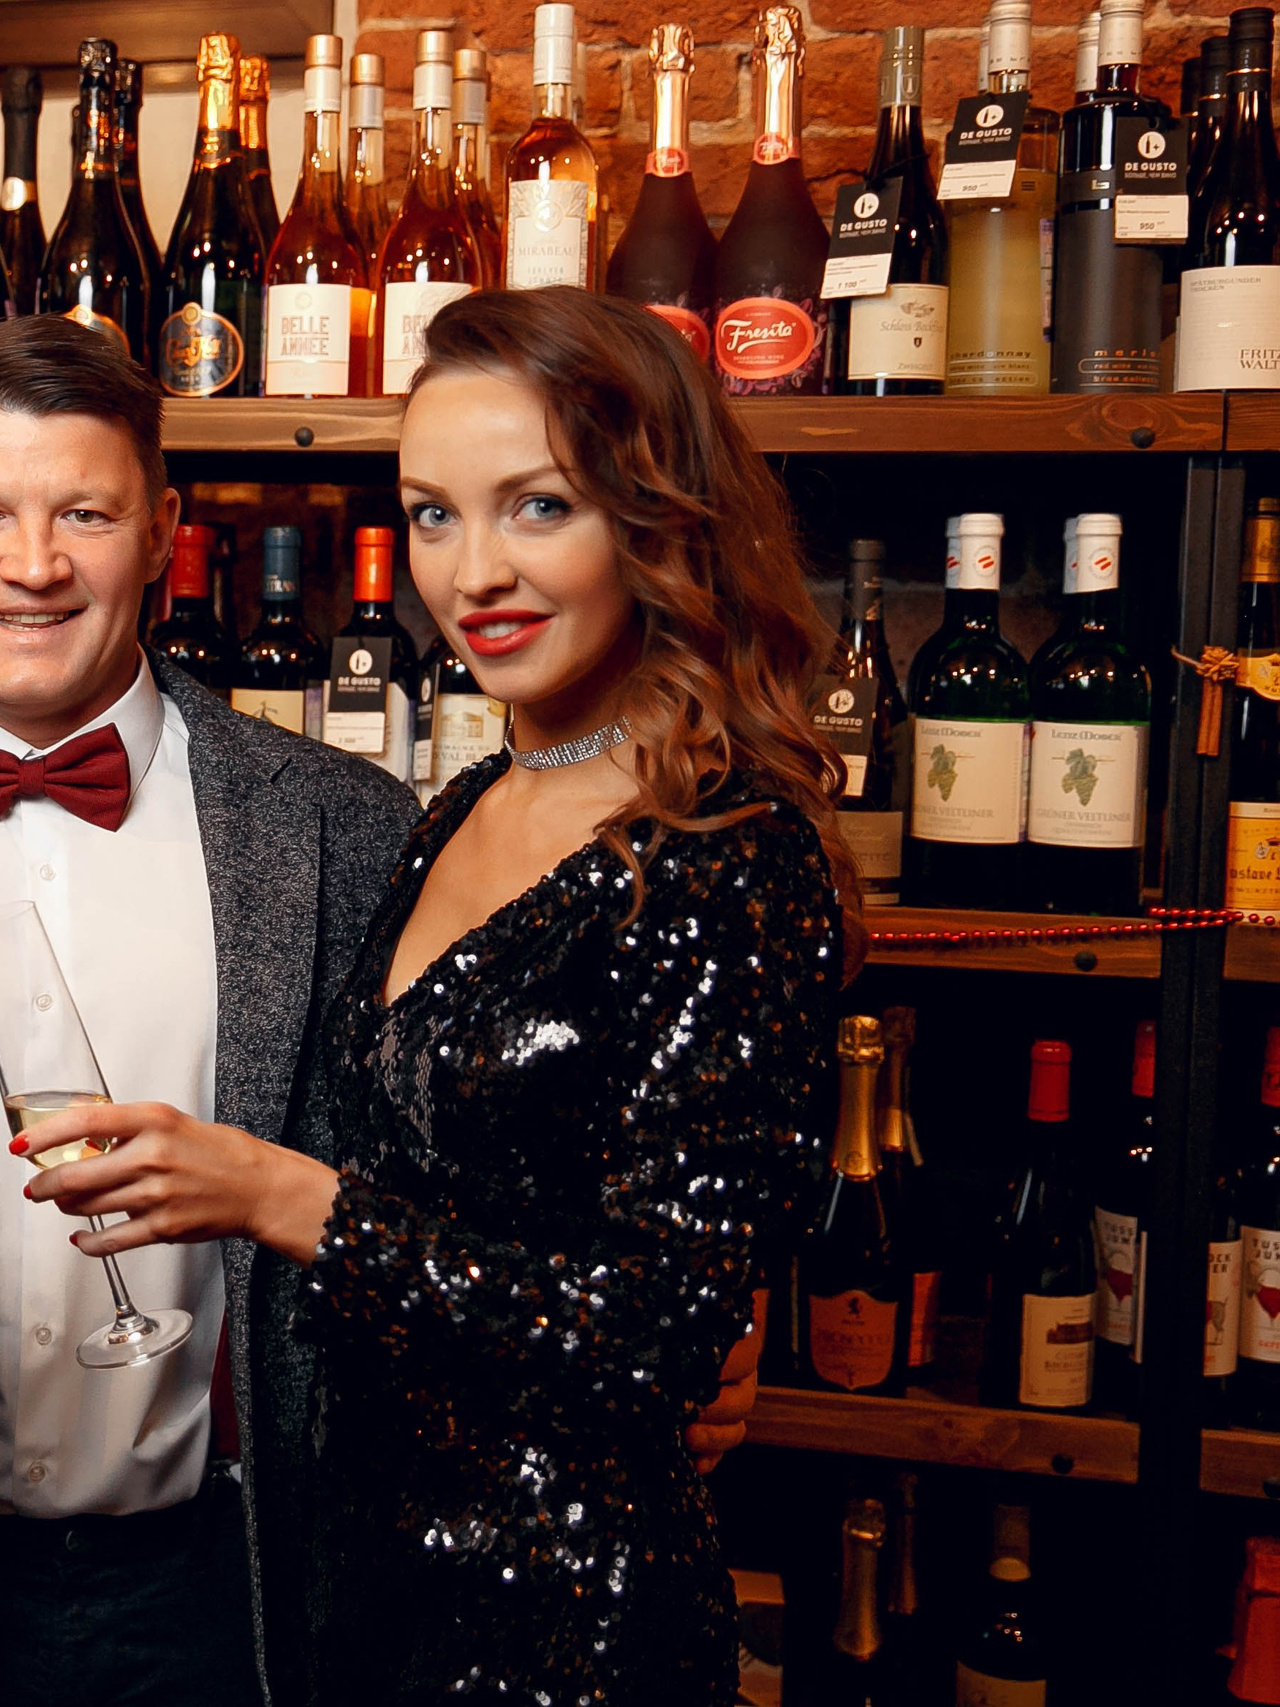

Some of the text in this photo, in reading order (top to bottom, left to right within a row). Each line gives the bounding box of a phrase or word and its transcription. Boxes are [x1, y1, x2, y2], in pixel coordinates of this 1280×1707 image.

[960, 127, 1012, 140] DE GUSTO
[1124, 162, 1177, 171] DE GUSTO
[840, 218, 887, 232] DE GUSTO
[281, 315, 330, 335] BELLE
[721, 319, 793, 351] Fresita
[1094, 349, 1159, 357] merlo
[1240, 359, 1280, 369] WALT
[337, 676, 381, 686] DE GUSTO
[814, 715, 863, 727] DE GUSTO
